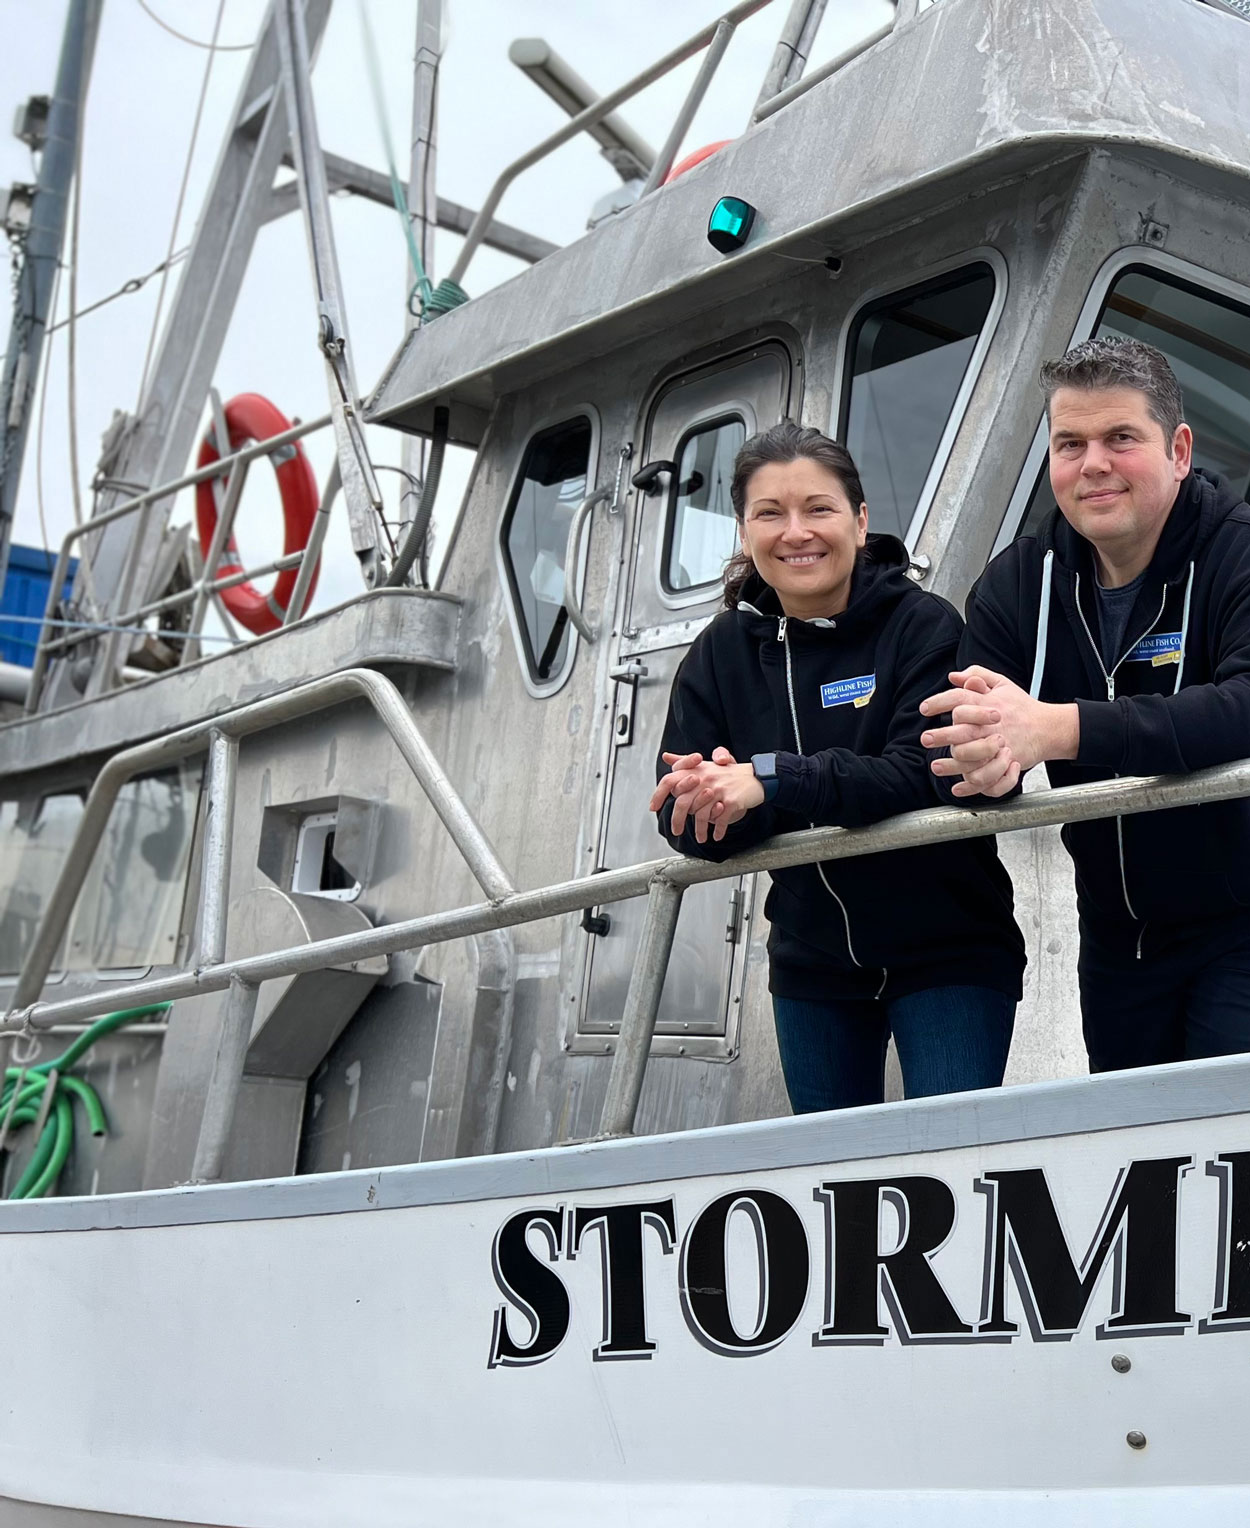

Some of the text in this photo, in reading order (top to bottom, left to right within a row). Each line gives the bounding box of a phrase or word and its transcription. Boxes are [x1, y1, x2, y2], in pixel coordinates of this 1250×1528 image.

[1155, 638, 1170, 647] FISH
[824, 680, 873, 696] HIGHLINE FISH
